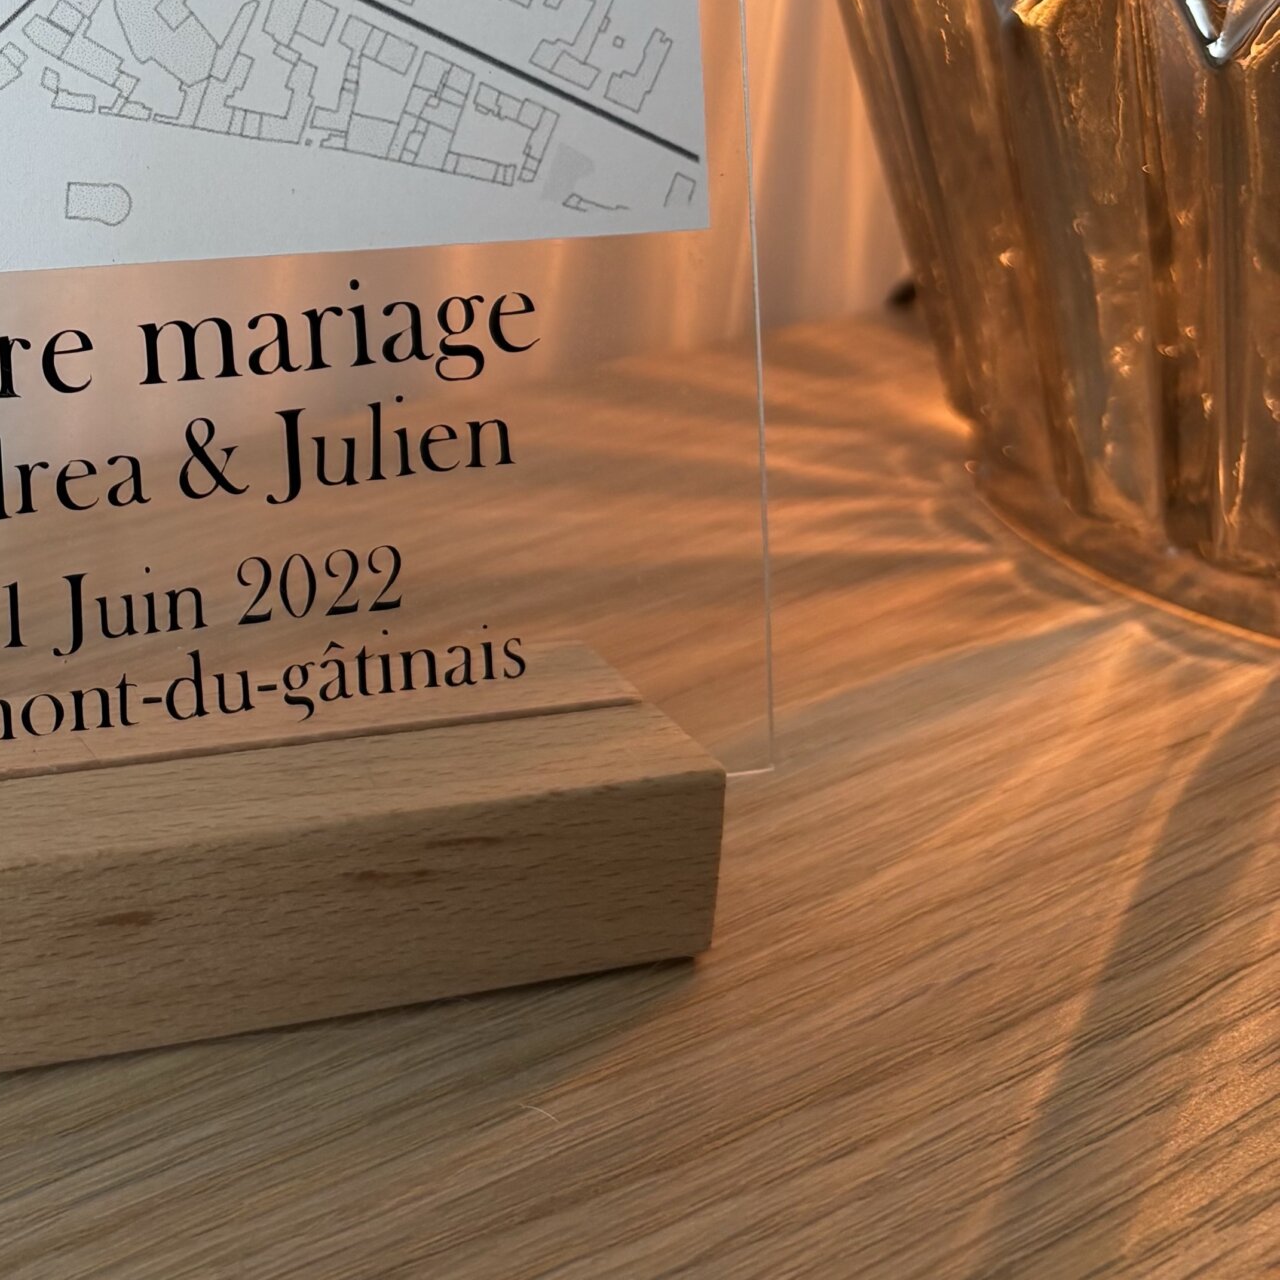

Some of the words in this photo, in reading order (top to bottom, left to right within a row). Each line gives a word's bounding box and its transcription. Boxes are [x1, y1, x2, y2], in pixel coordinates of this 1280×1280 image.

[138, 278, 542, 383] mariage
[177, 416, 250, 500] &
[266, 394, 516, 505] Julien
[51, 565, 210, 657] Juin
[235, 543, 404, 627] 2022
